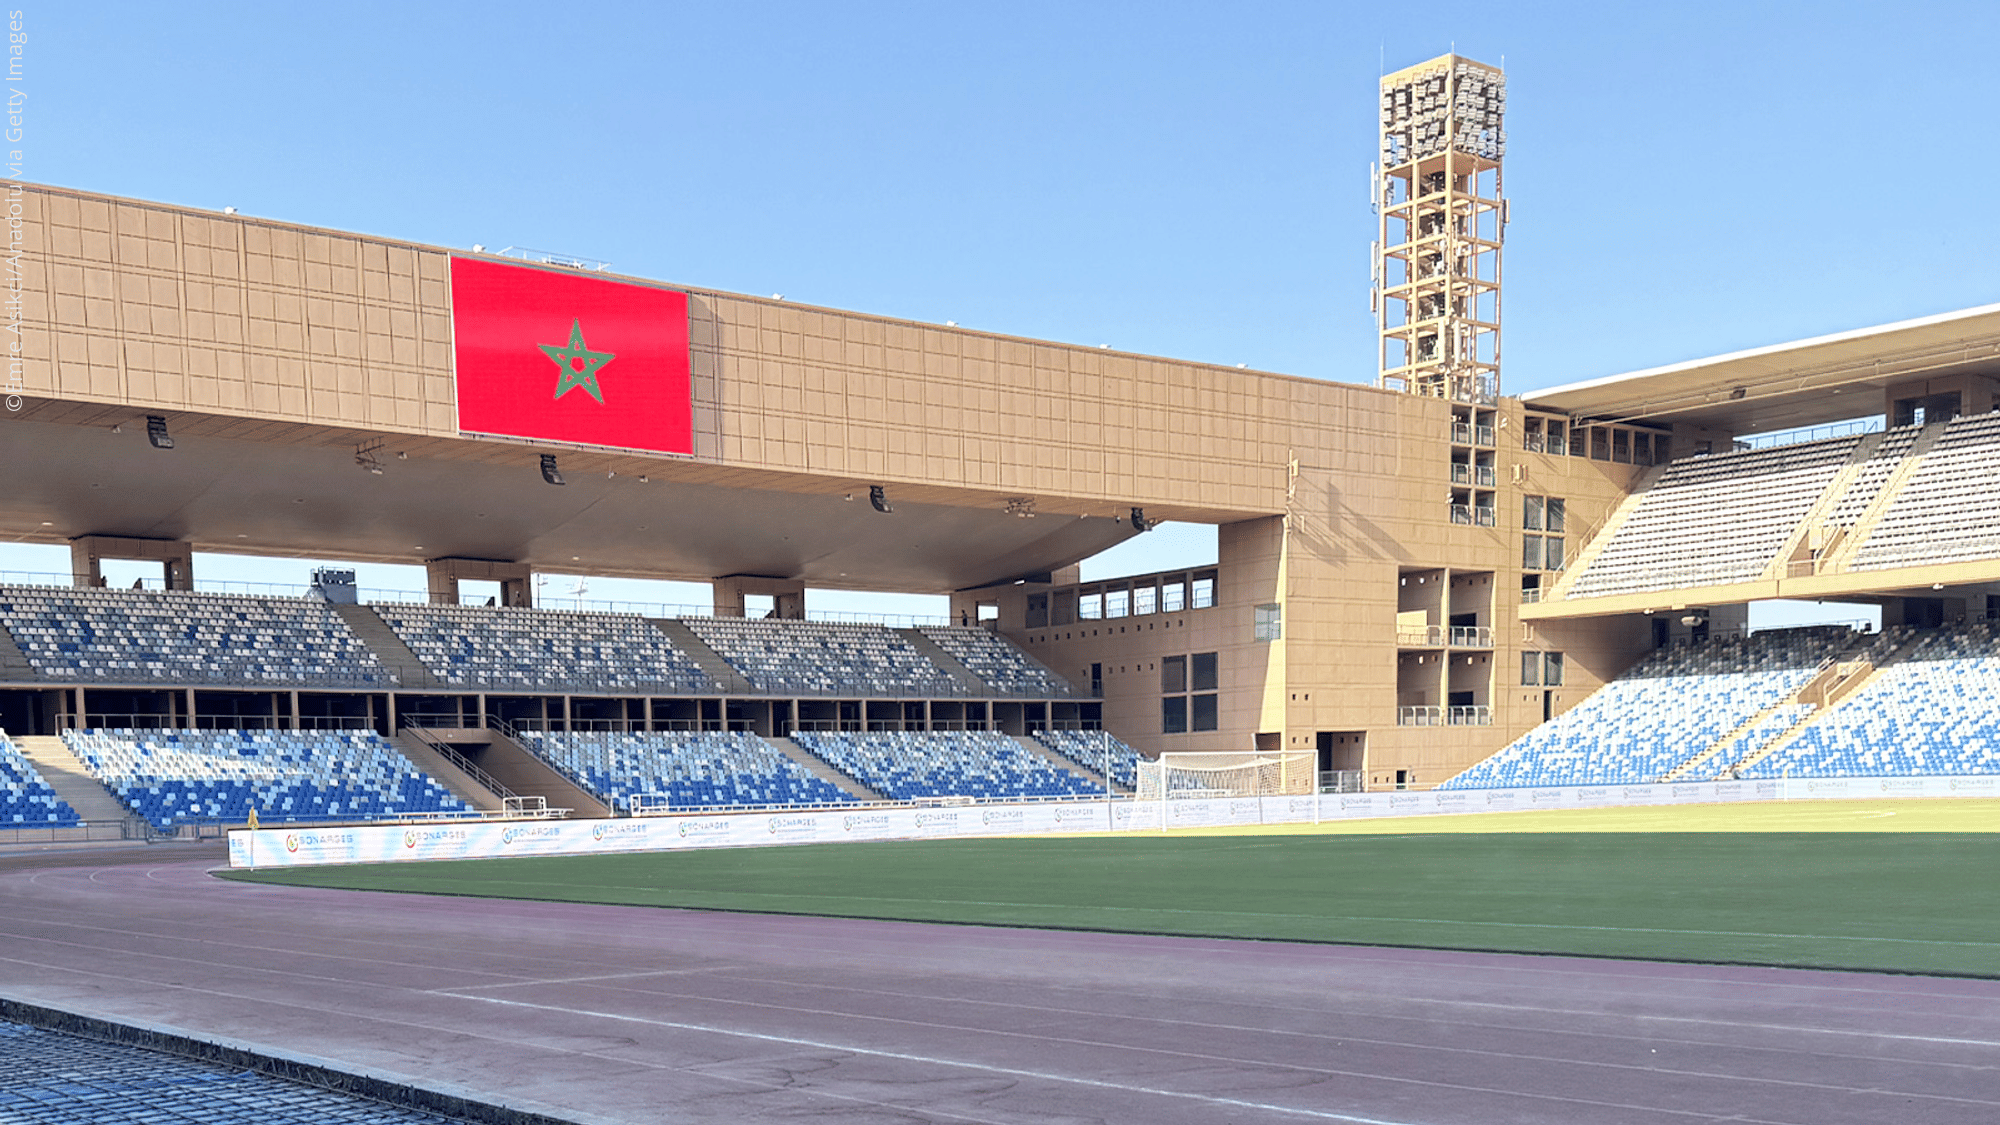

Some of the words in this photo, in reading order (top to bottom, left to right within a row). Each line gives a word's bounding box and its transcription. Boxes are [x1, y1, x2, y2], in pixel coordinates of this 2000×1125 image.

[416, 830, 466, 839] SONARGES
[514, 827, 561, 836] SONARGES
[299, 834, 353, 845] SONARGES
